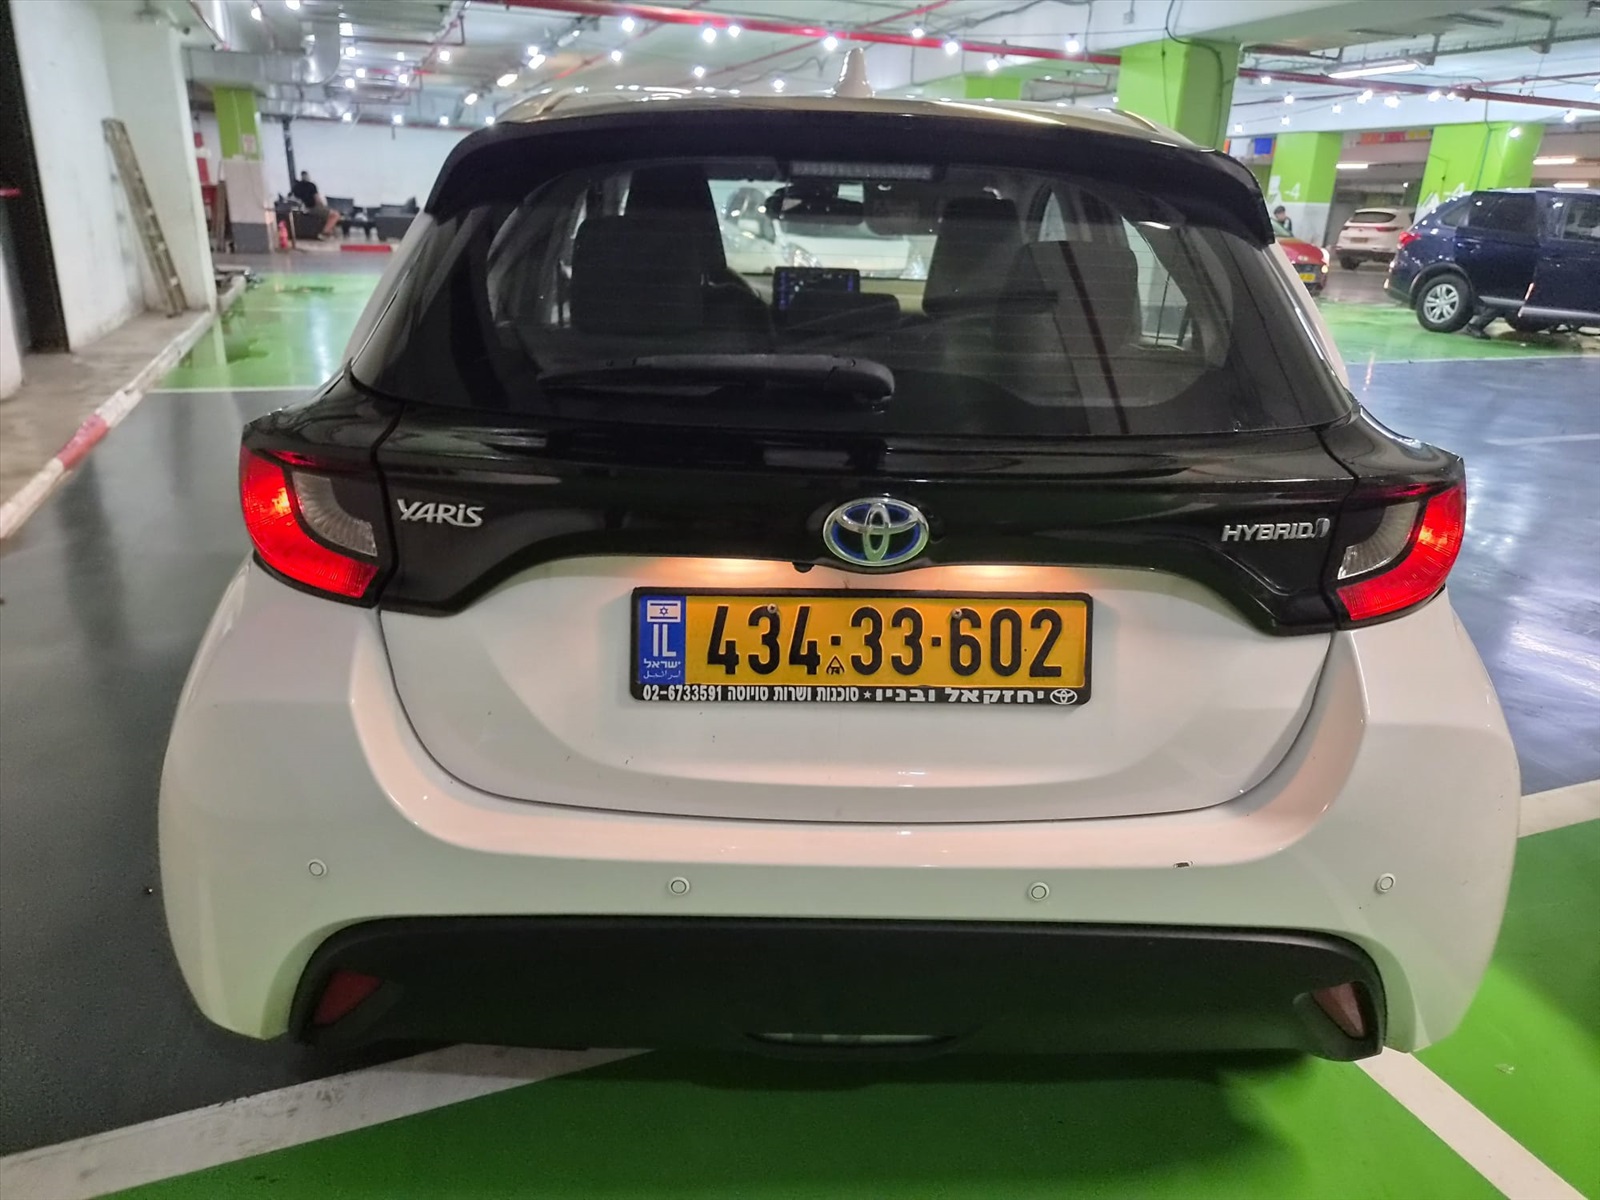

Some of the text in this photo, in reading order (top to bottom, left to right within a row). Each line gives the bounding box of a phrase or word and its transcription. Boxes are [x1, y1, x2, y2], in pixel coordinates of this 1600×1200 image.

[1221, 522, 1315, 541] HYBRID
[653, 623, 677, 657] IL
[643, 658, 682, 669] ישראל
[642, 684, 722, 701] 02-6733591
[773, 686, 812, 702] ושרות
[816, 686, 860, 702] סוכנות
[875, 688, 936, 702] ובניו
[944, 687, 1045, 704] יחזקאל
